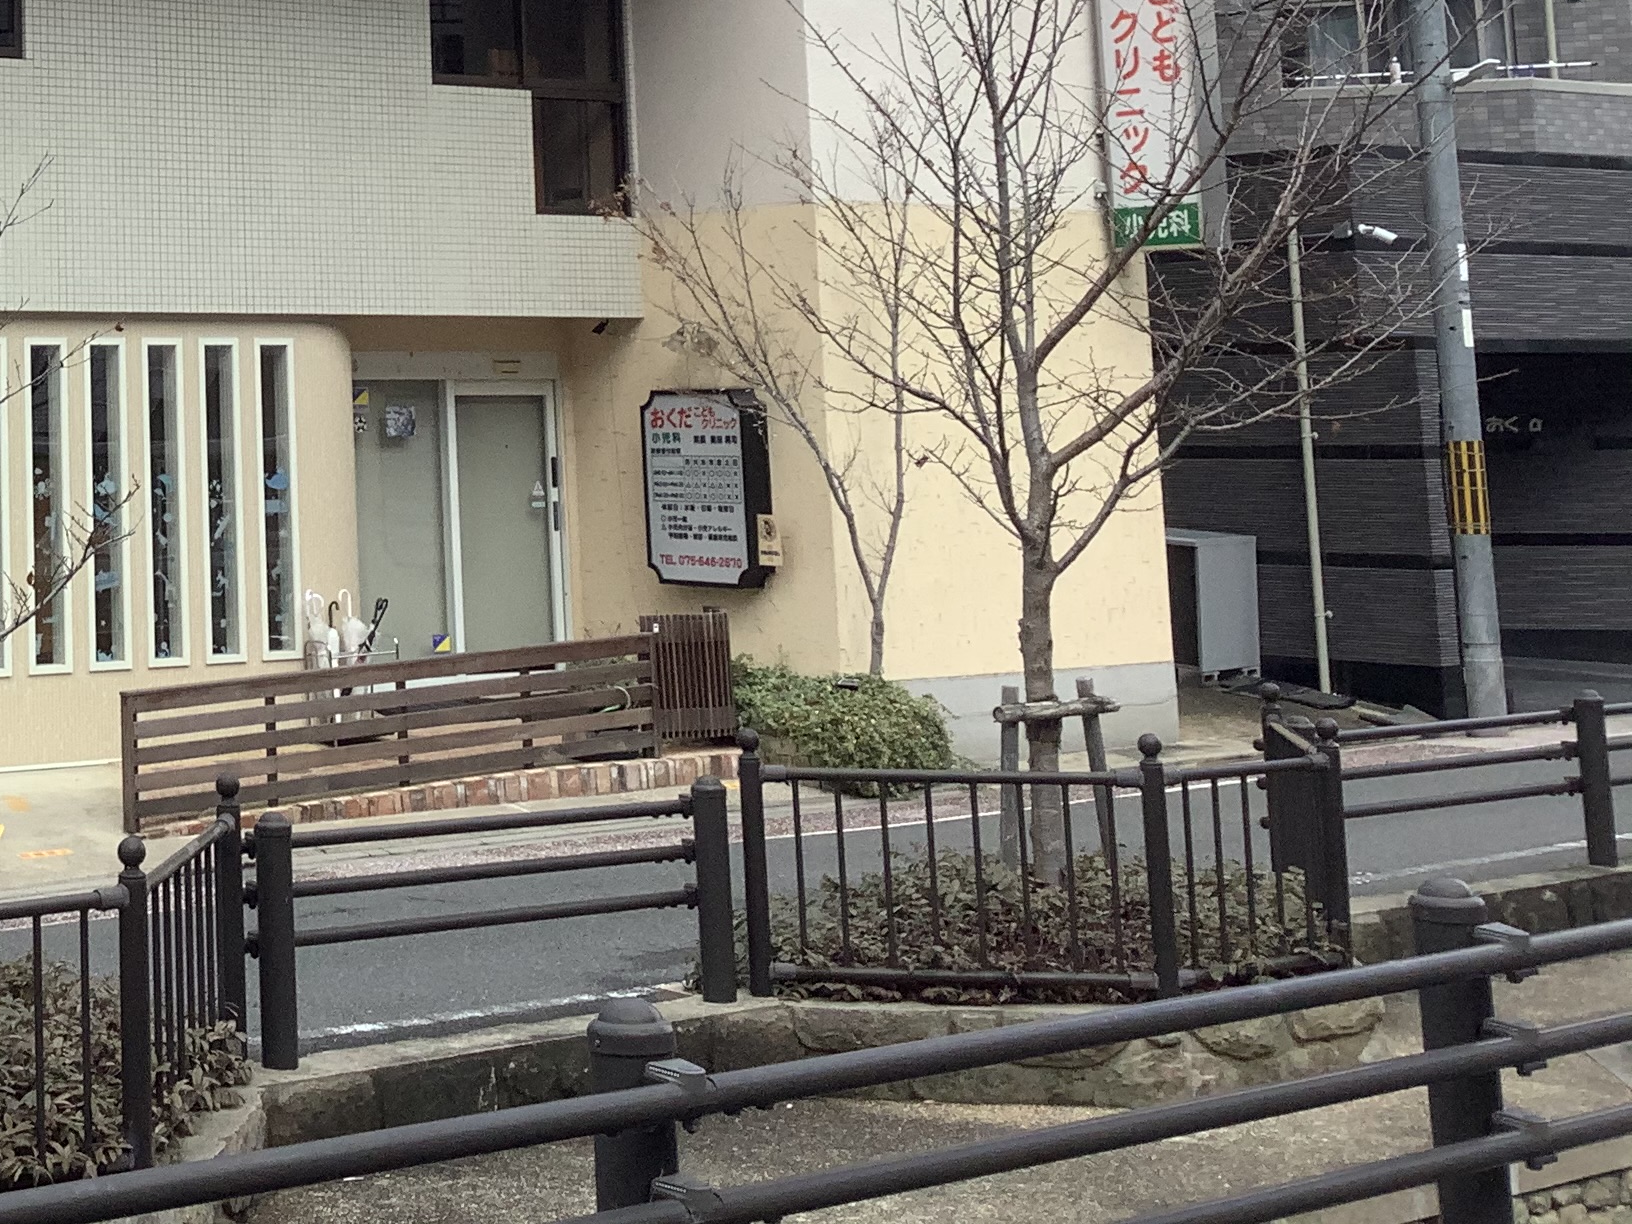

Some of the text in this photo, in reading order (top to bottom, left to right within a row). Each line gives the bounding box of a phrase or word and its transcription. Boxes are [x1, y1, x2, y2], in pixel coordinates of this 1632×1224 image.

[1110, 10, 1150, 194] クリニック
[650, 407, 693, 429] おくだ
[694, 406, 715, 418] こども
[701, 417, 737, 430] クリニック
[652, 432, 681, 444] 小児科
